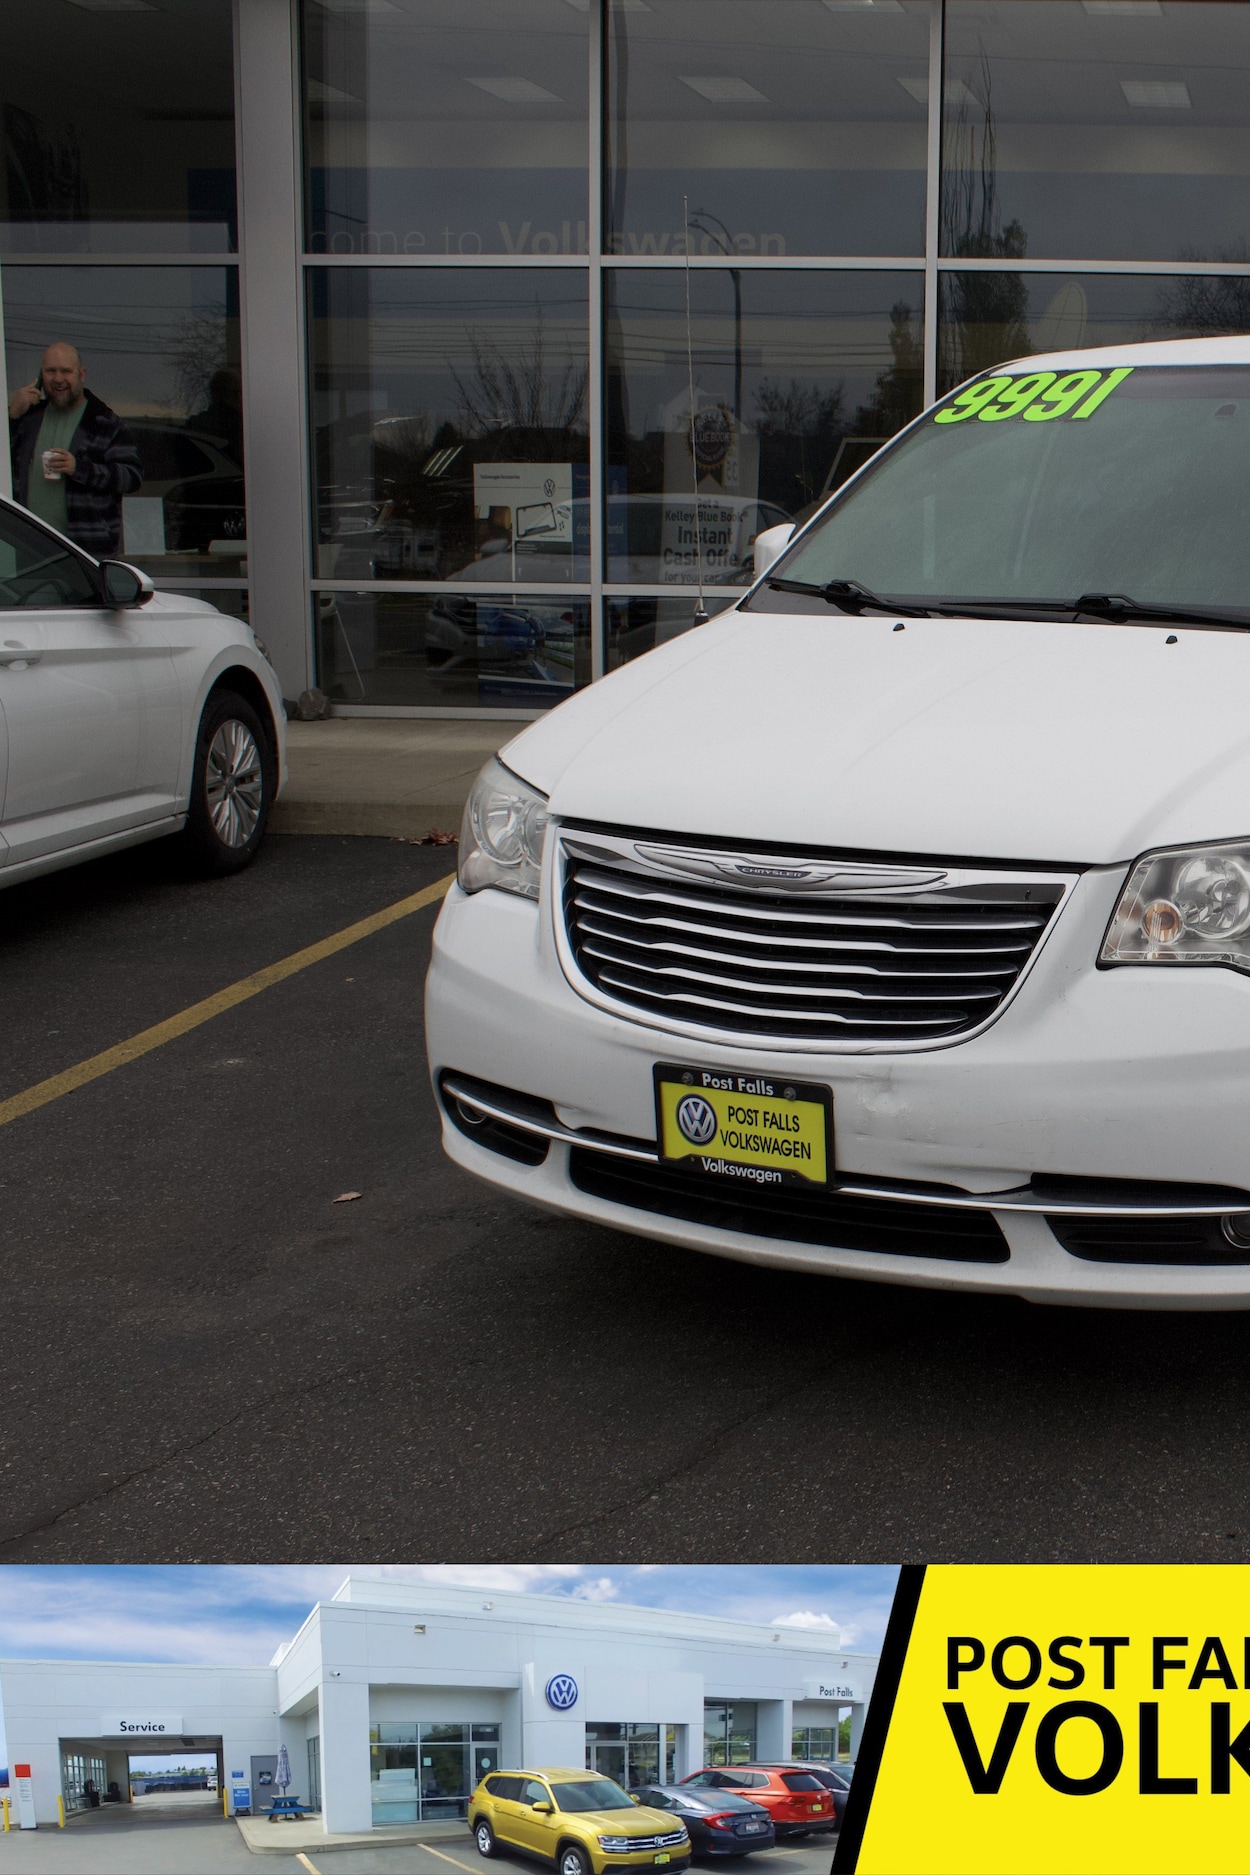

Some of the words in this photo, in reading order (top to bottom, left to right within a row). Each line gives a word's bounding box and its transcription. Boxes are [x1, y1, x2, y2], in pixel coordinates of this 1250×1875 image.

[934, 367, 1134, 424] 9991
[665, 511, 695, 524] Kelley
[698, 511, 718, 522] Blue
[678, 526, 733, 545] Instant
[664, 548, 700, 566] Cash
[706, 548, 739, 567] Offe
[664, 571, 678, 582] for
[741, 866, 804, 879] CHRYSLER
[702, 1073, 734, 1092] Post
[737, 1077, 774, 1096] Falls
[728, 1105, 760, 1128] POST
[763, 1111, 800, 1133] FALLS
[720, 1129, 812, 1160] VOLKSWAGEN
[701, 1156, 782, 1184] Volkswagen
